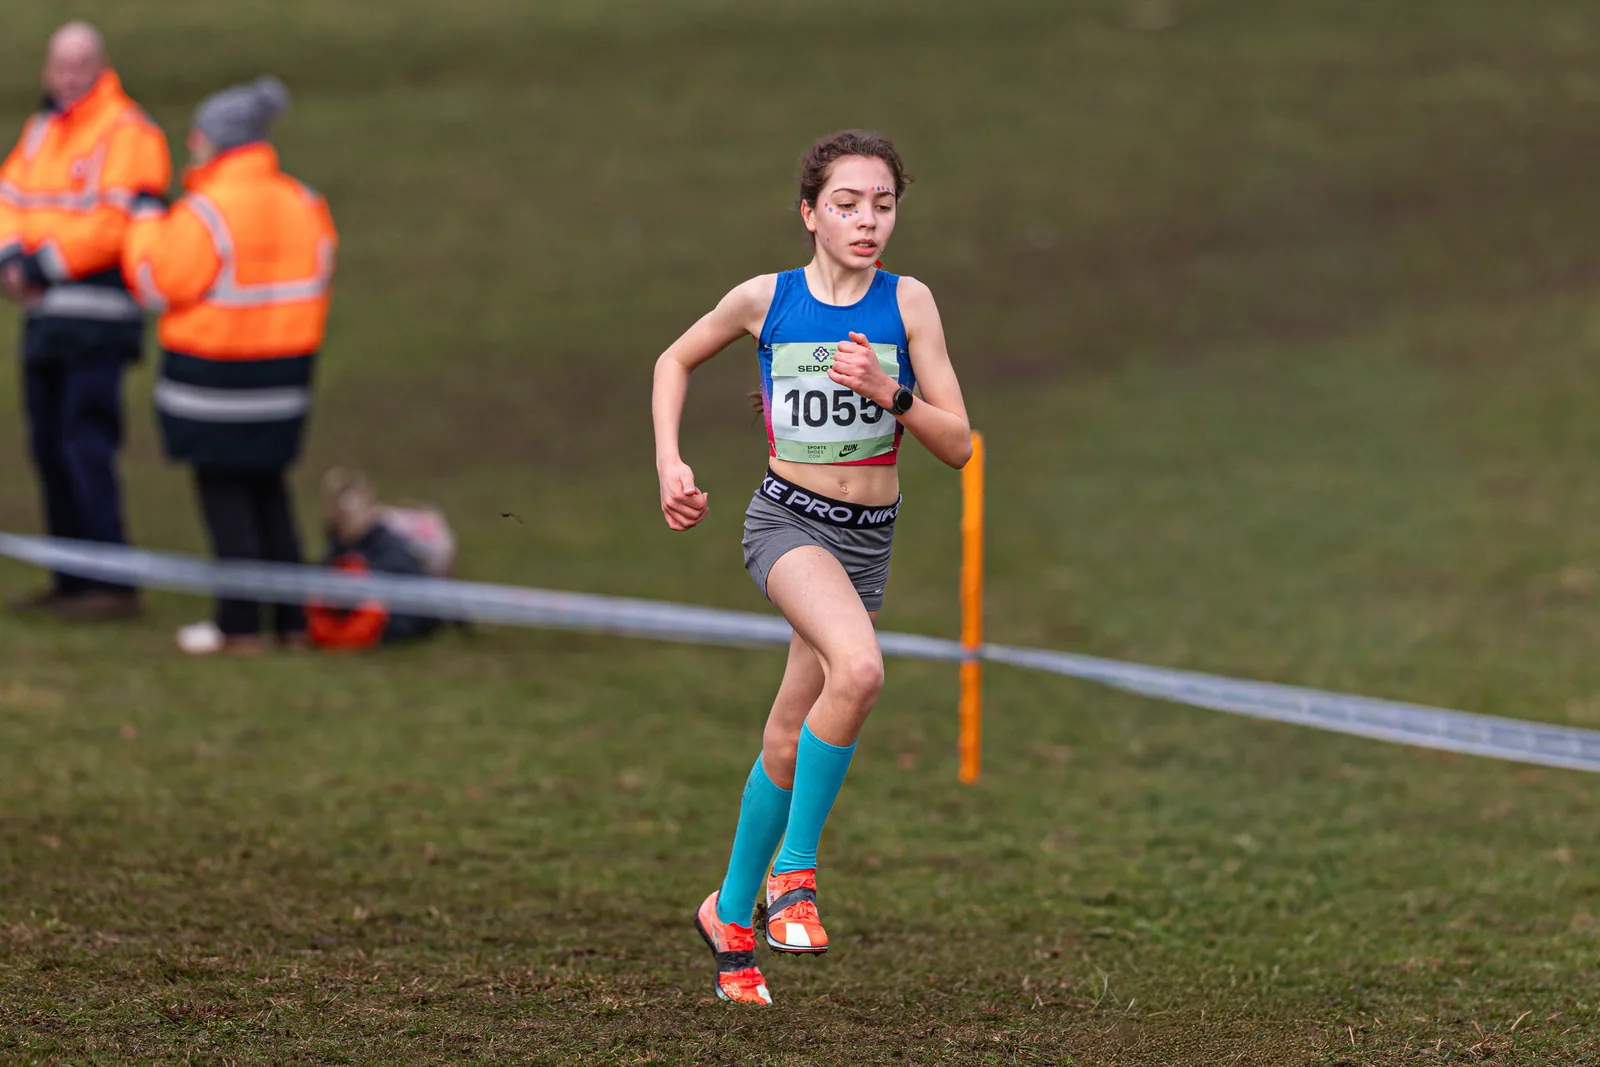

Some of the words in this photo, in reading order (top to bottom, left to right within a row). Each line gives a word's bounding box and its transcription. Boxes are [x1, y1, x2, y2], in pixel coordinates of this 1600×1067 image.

[784, 389, 884, 428] 1055
[843, 444, 858, 452] RUN
[785, 490, 853, 522] PRO
